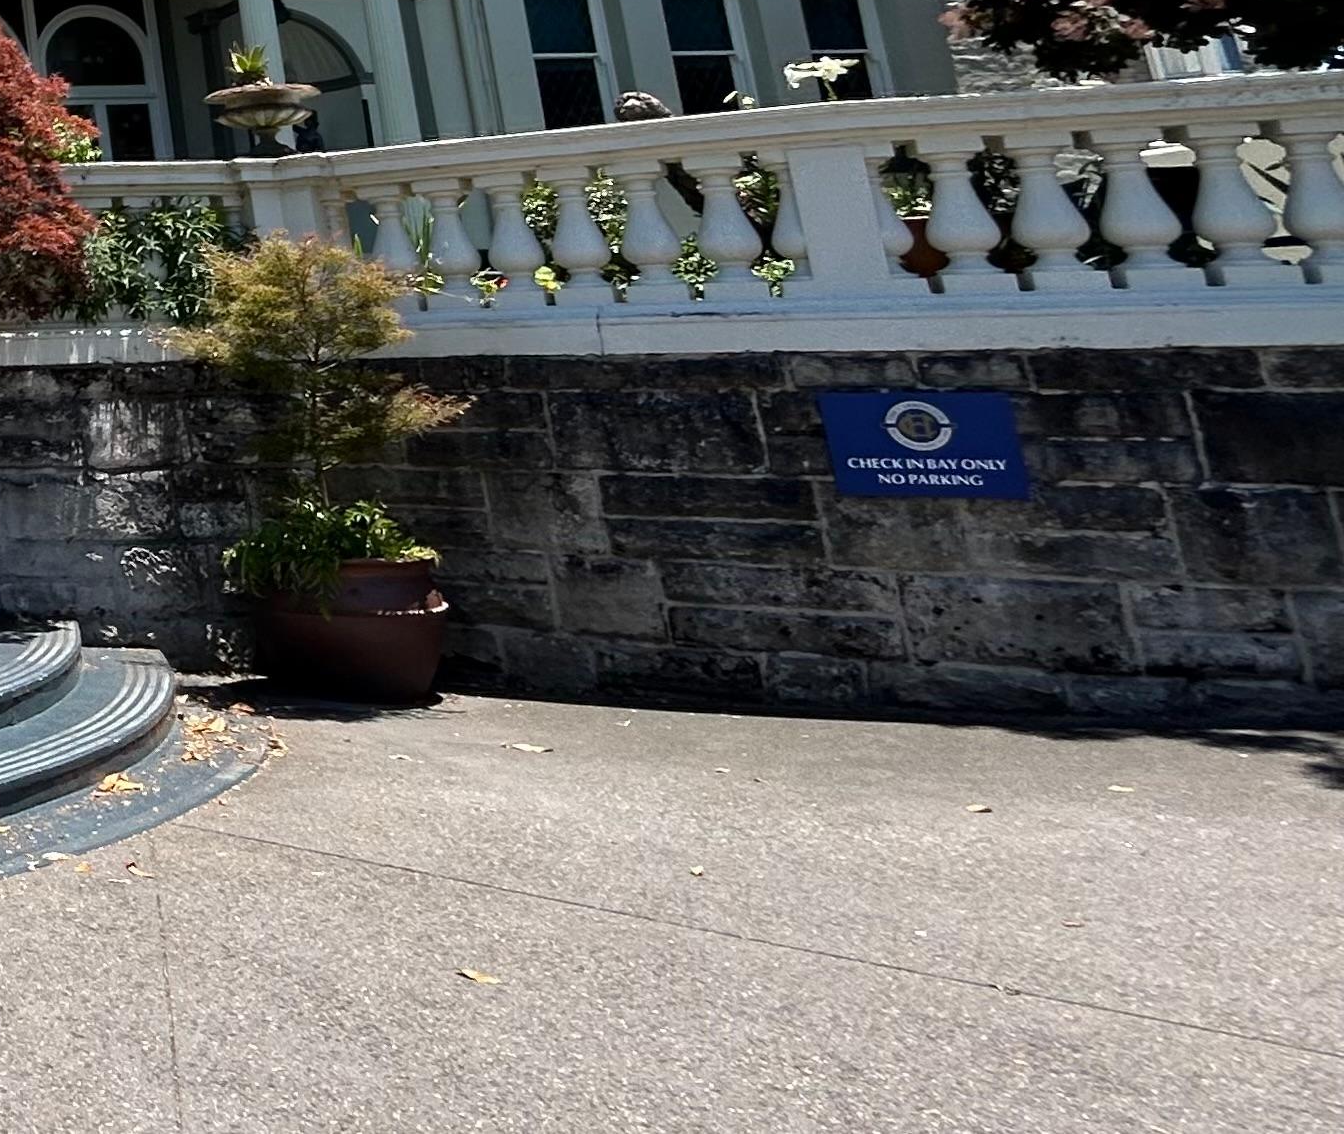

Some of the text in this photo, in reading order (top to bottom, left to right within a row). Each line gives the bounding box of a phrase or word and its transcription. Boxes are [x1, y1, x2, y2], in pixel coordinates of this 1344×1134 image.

[847, 457, 1007, 470] CHECK IN BAY ONLY
[877, 473, 984, 486] NO PARKING
